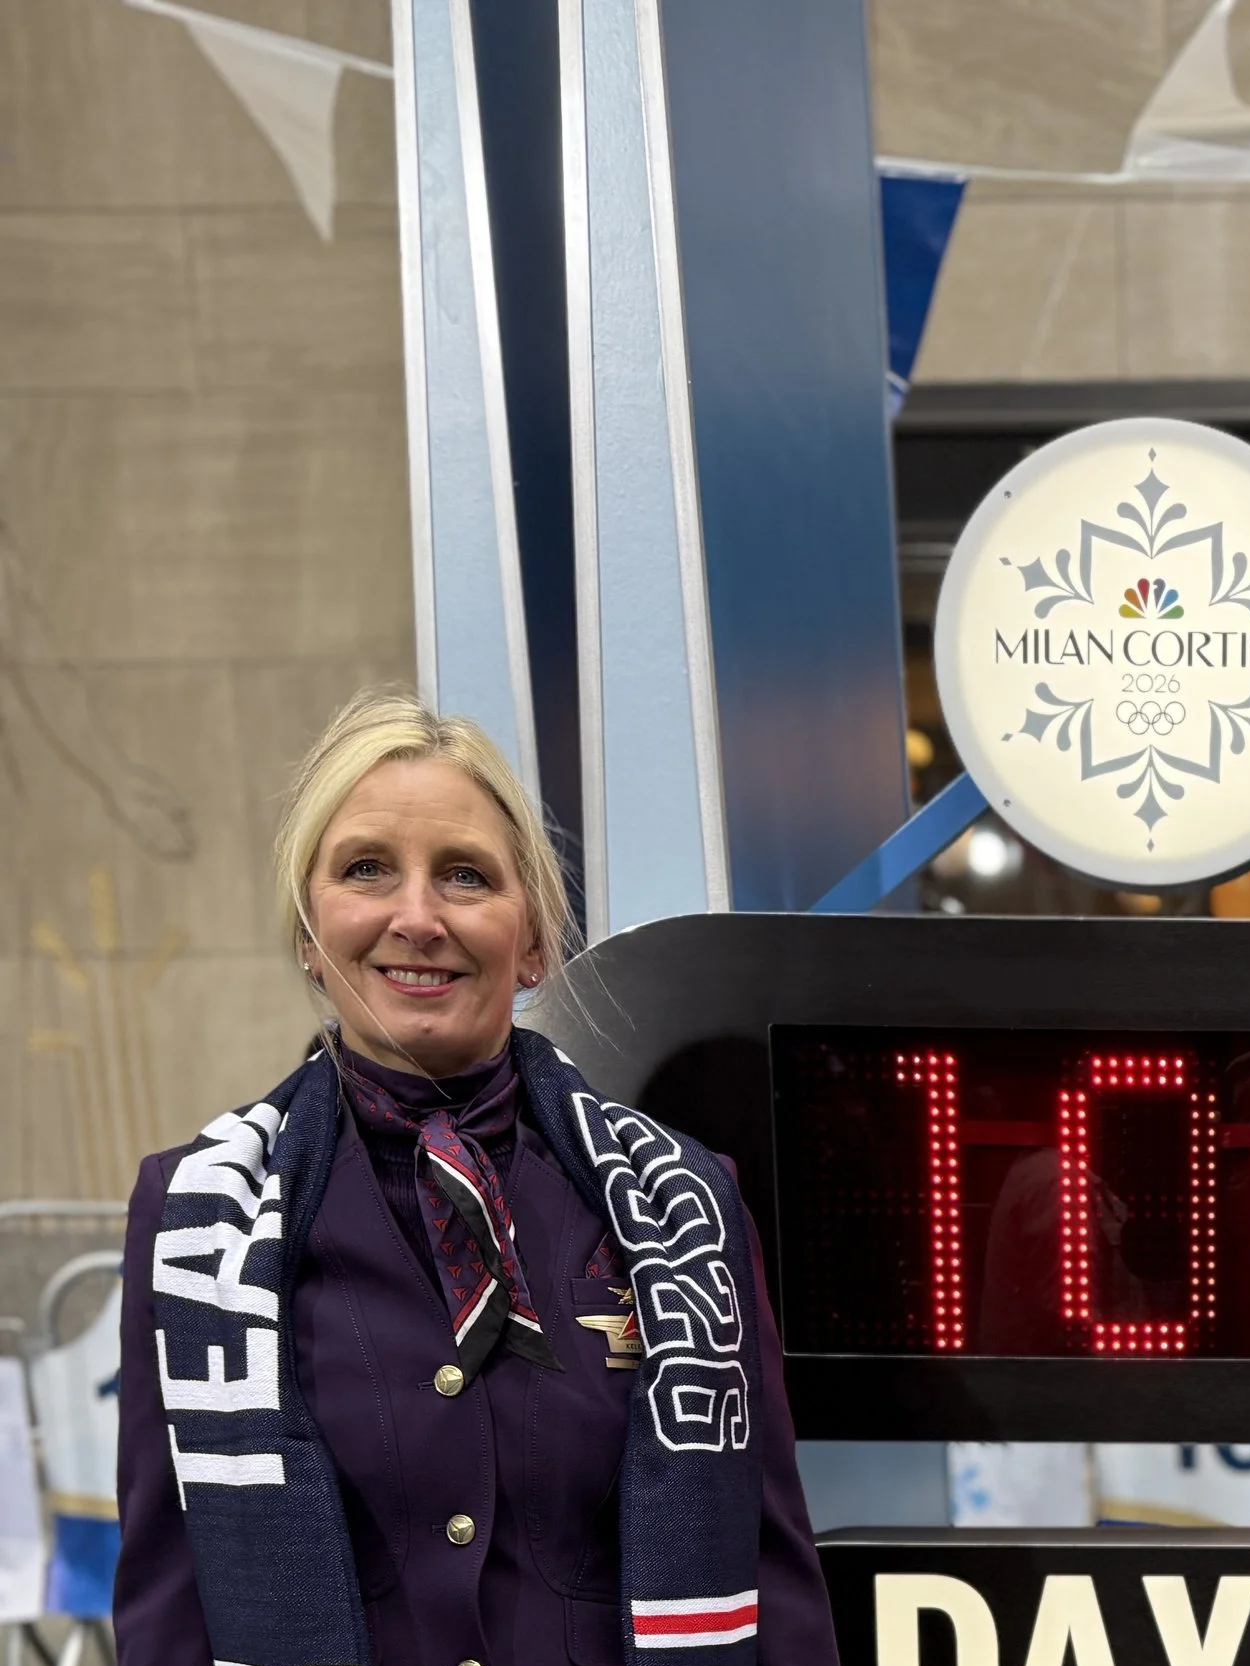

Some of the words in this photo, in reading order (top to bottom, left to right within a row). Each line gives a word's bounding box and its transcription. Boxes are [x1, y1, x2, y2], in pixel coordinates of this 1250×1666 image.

[995, 627, 1113, 666] MILAN
[1121, 673, 1181, 693] 2026
[153, 1103, 288, 1511] TEAM
[571, 1092, 749, 1452] 2026
